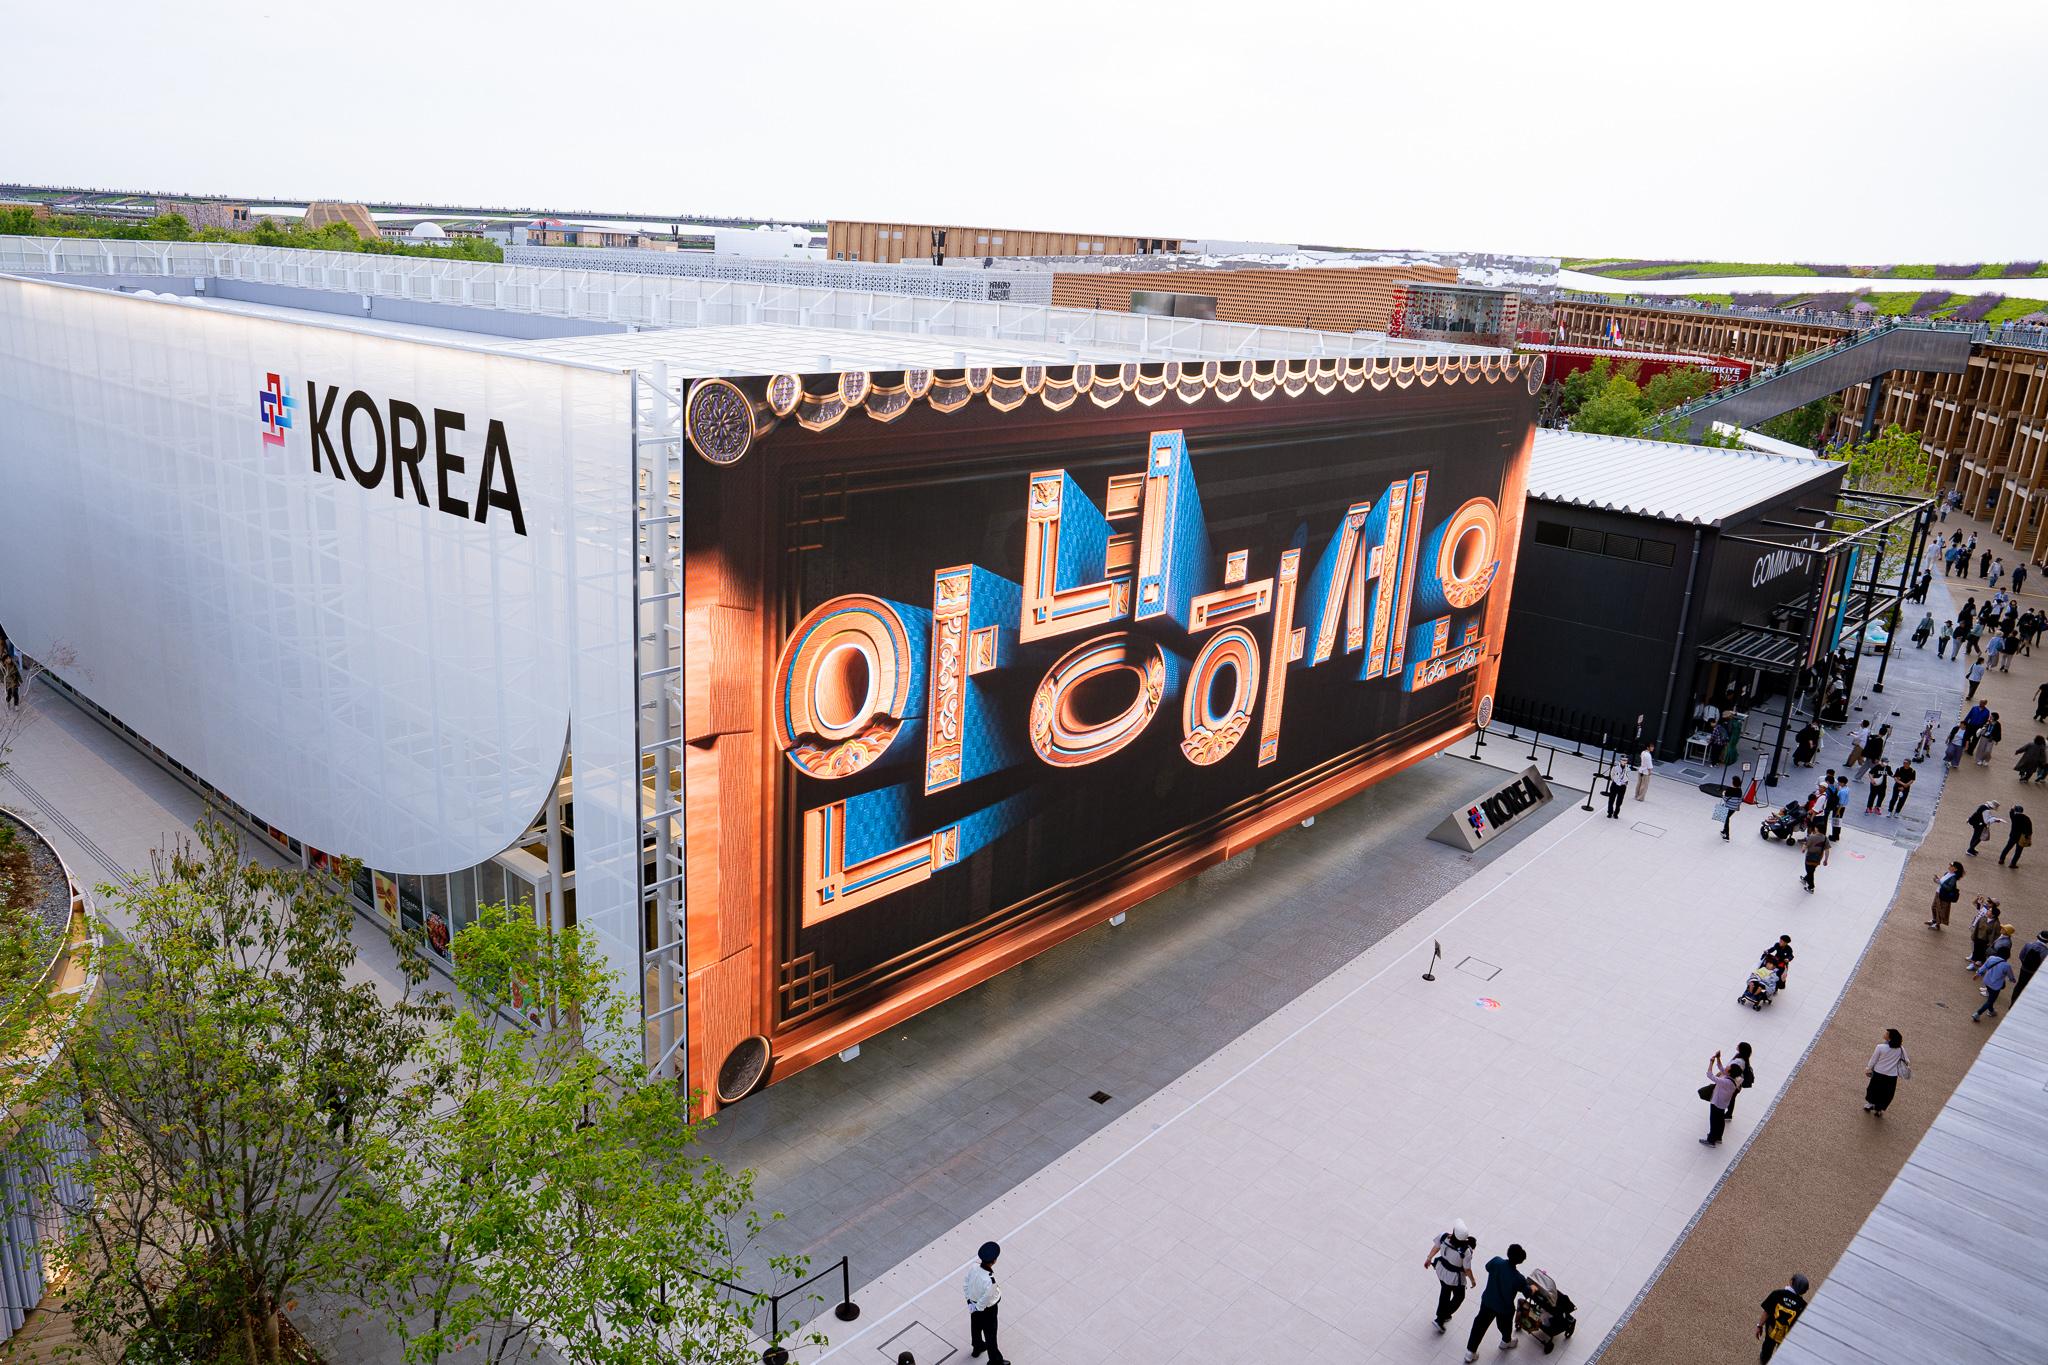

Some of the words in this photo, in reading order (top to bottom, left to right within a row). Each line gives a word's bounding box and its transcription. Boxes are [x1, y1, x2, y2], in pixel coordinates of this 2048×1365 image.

[307, 379, 527, 536] KOREA
[773, 428, 1501, 929] 안녕하세요
[1479, 775, 1544, 830] KOREA
